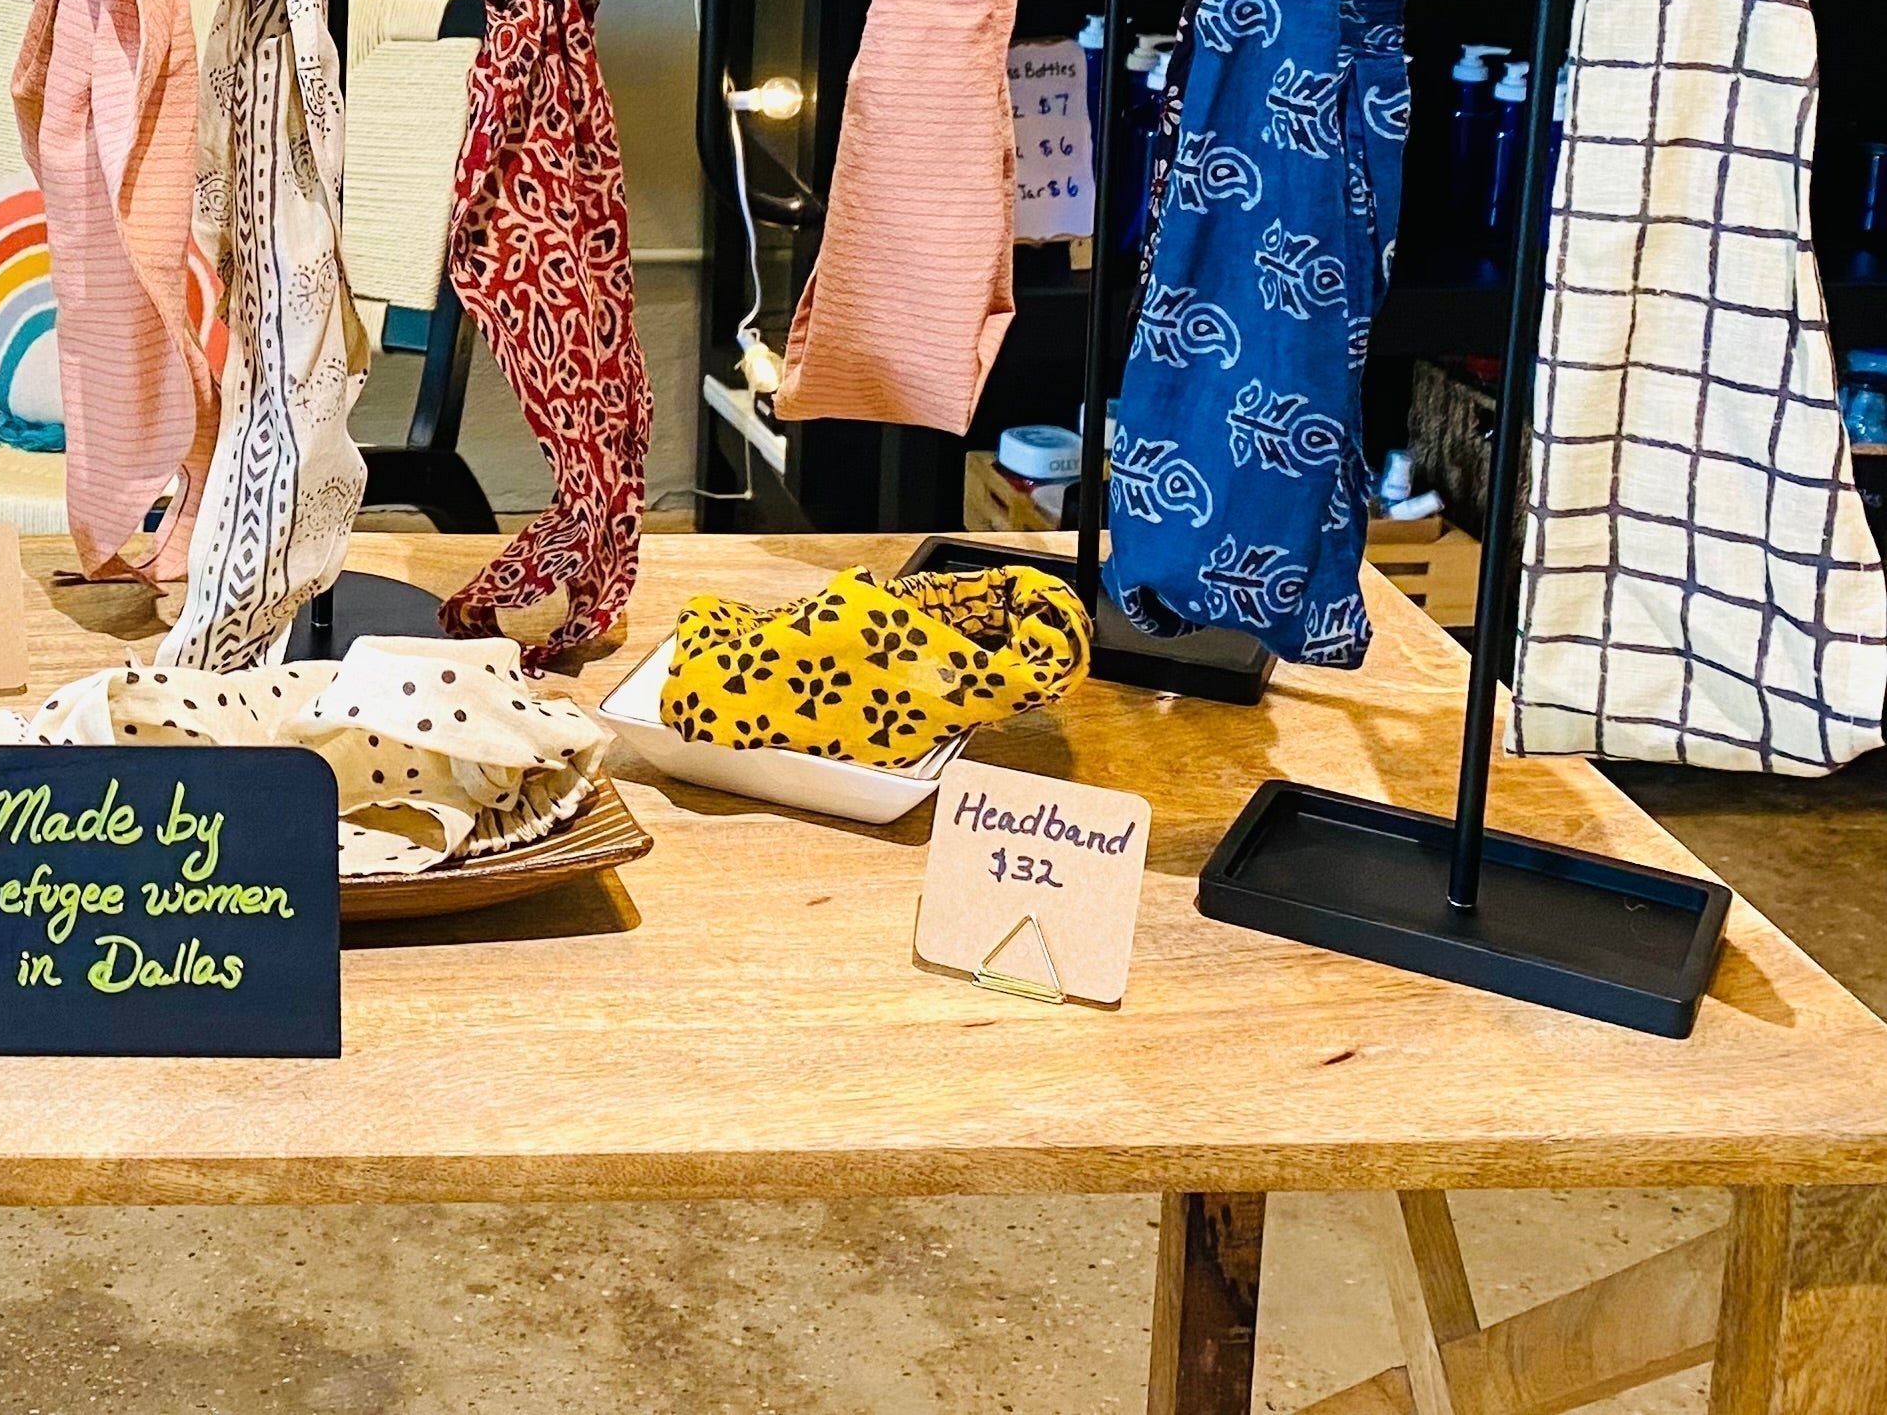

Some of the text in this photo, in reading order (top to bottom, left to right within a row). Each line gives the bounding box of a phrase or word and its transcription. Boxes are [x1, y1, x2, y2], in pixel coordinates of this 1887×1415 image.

[1025, 60, 1076, 79] Bottles
[156, 780, 226, 882] by
[953, 792, 1136, 855] Headband
[988, 847, 1063, 888] $32
[142, 878, 296, 918] women
[17, 934, 246, 993] in Dallas
